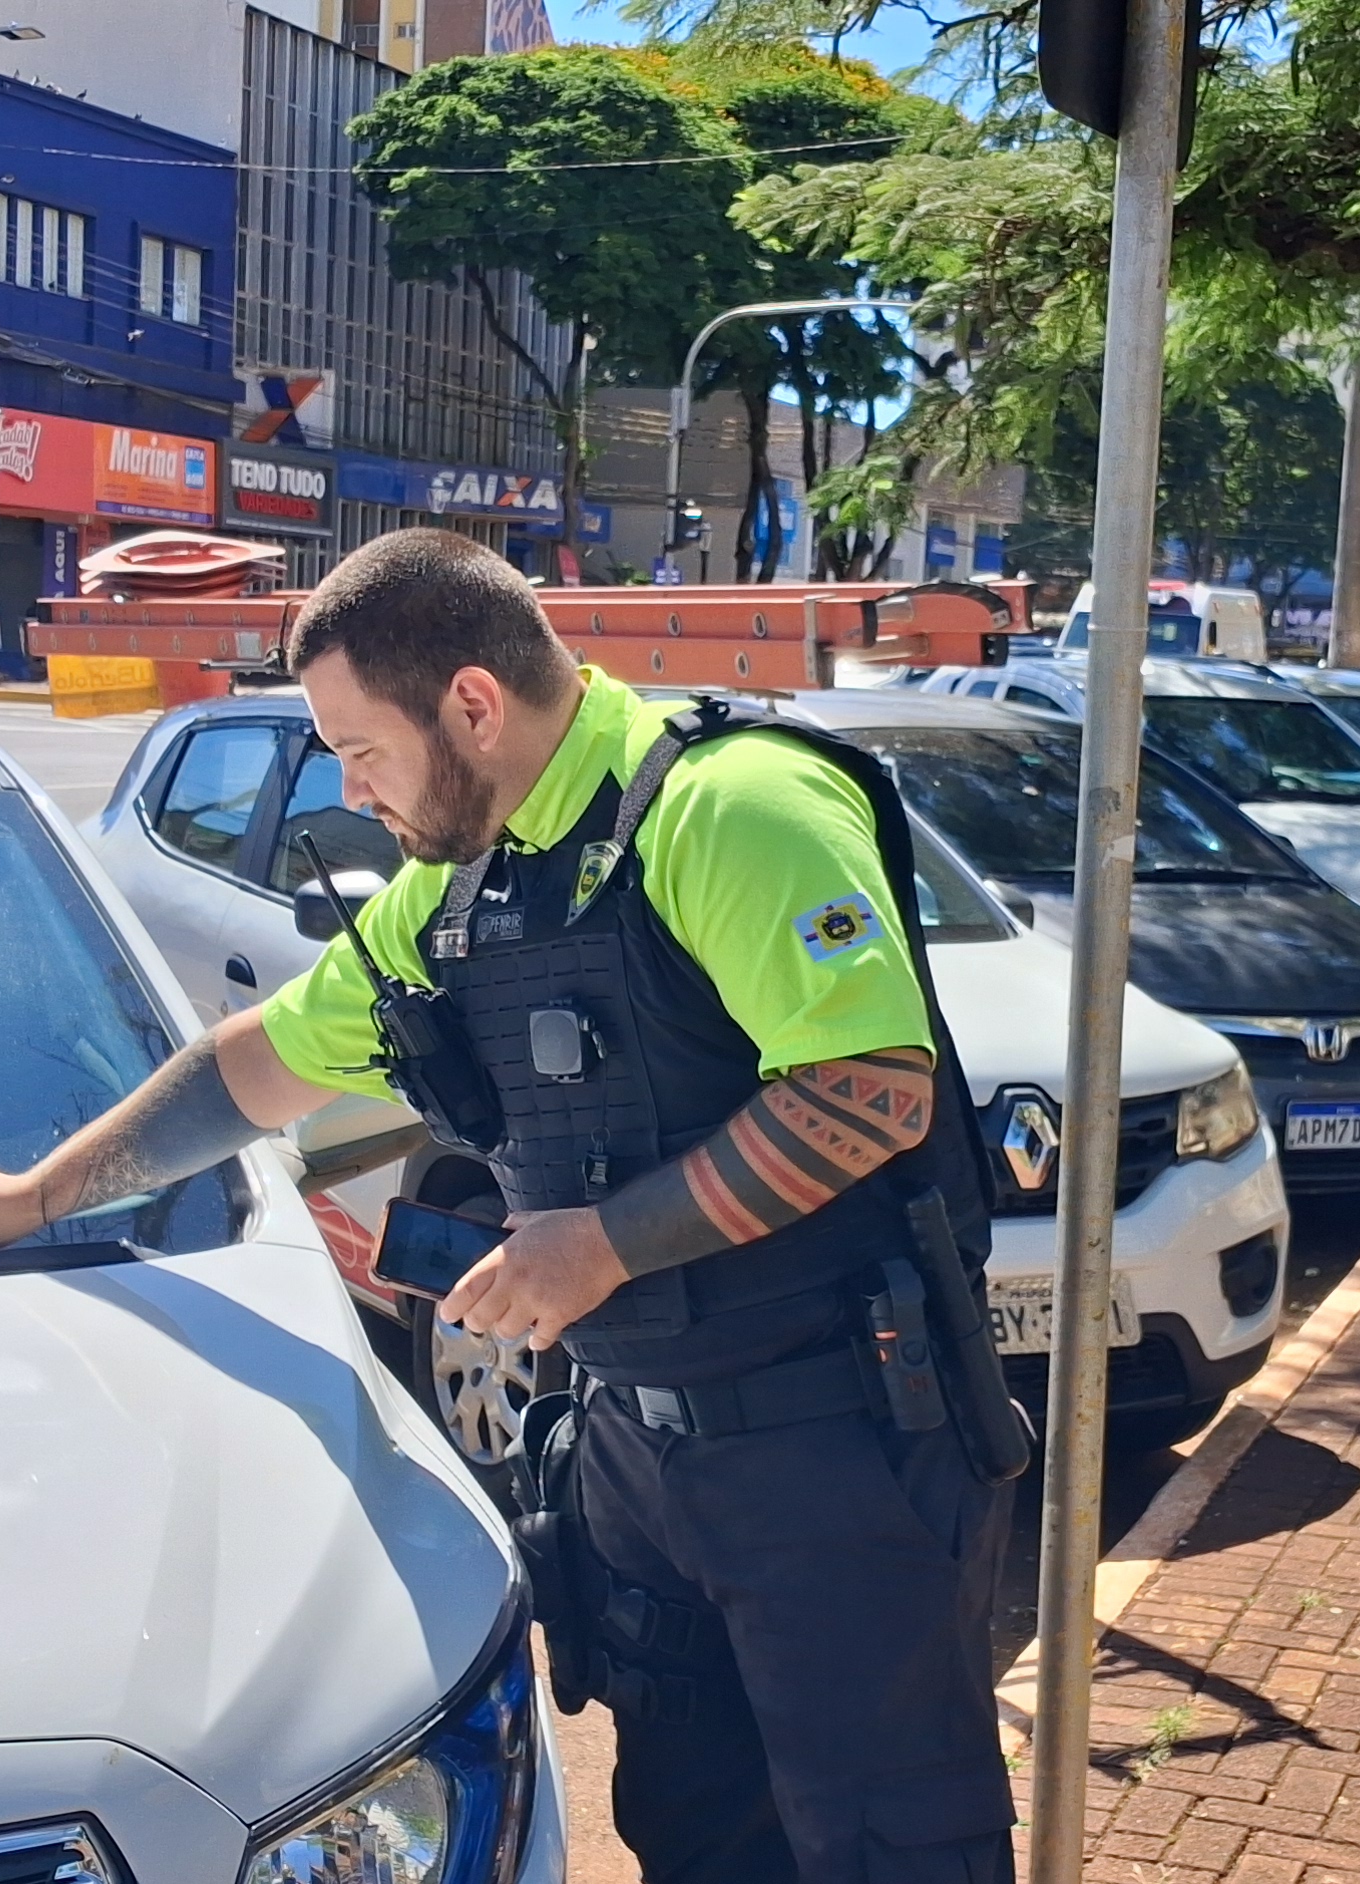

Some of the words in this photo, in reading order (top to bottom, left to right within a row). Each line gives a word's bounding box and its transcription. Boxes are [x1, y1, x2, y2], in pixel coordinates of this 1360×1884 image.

[108, 429, 177, 480] Marina
[230, 458, 278, 492] TEND
[279, 465, 326, 501] TUDO
